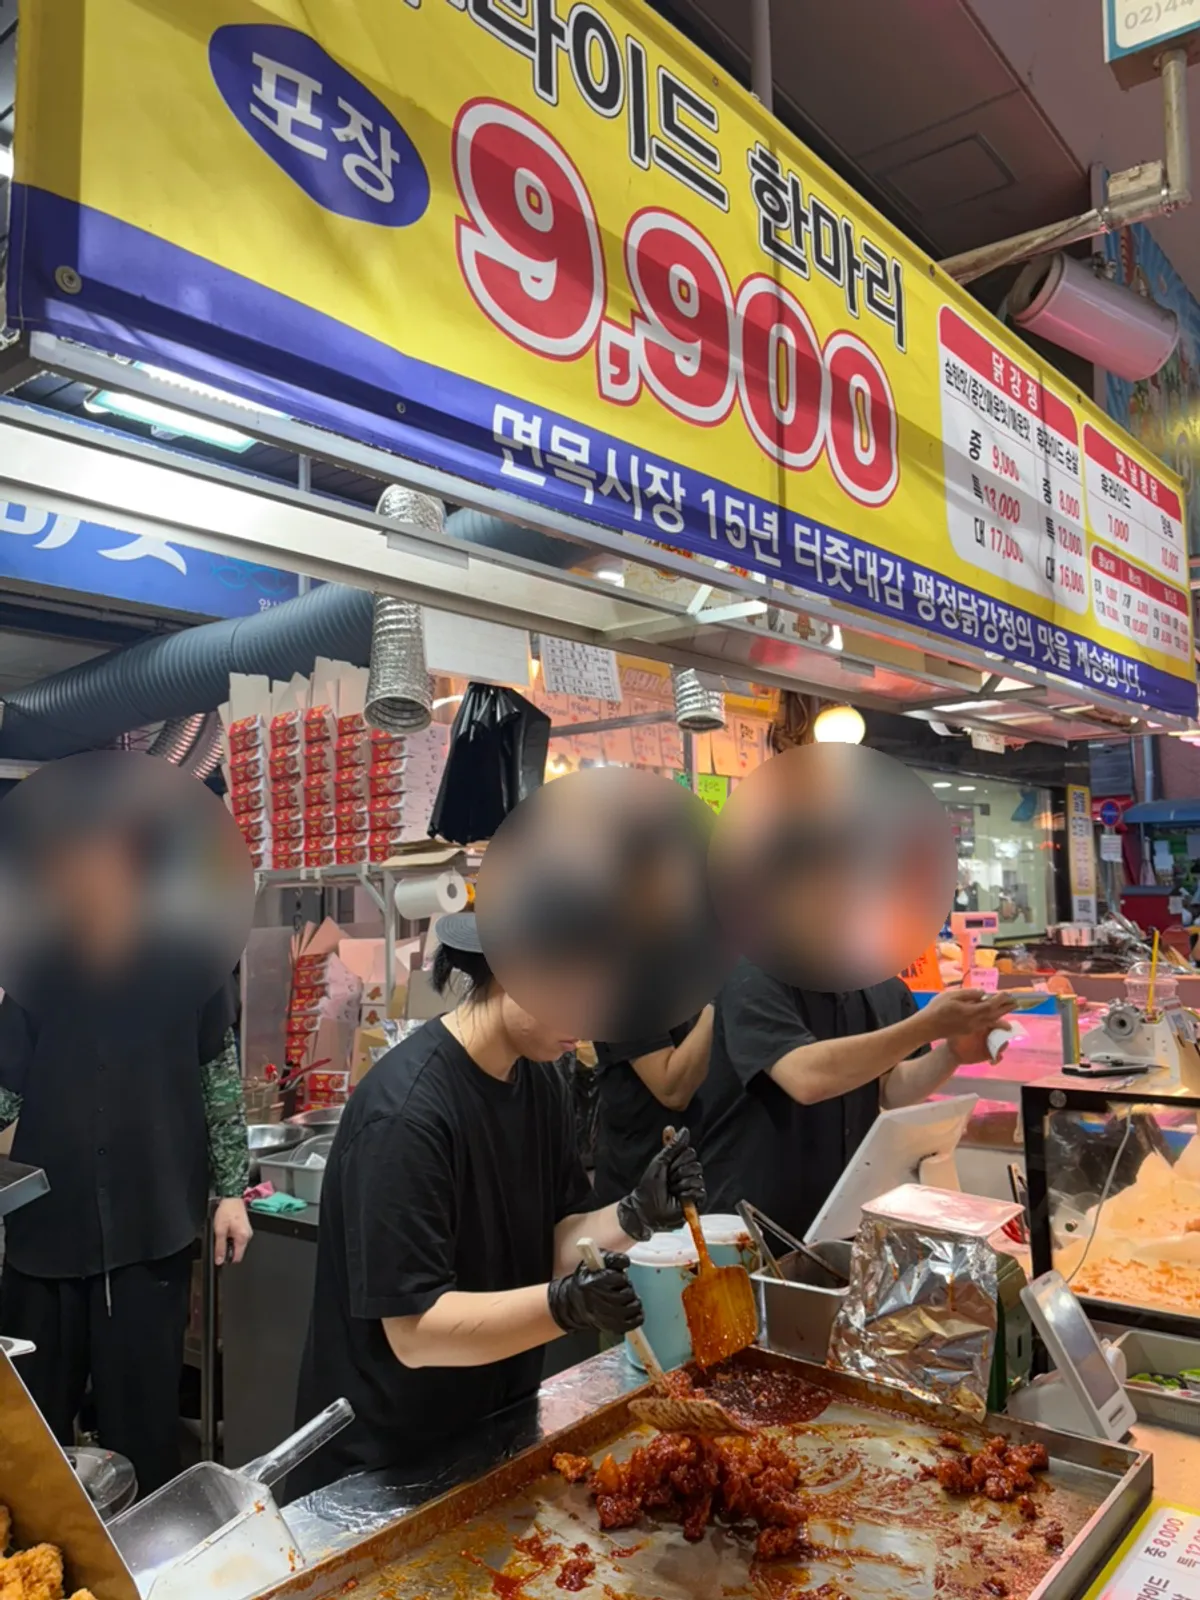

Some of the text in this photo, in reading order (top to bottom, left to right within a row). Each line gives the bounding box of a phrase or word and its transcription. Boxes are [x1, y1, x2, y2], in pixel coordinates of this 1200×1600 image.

[249, 52, 401, 204] 포장
[401, 0, 907, 354] 라이드 한마리
[451, 96, 899, 507] 9,900
[969, 429, 1020, 482] 중 9,000
[984, 485, 1021, 524] 13,000
[1043, 477, 1053, 505] 중
[493, 403, 686, 534] 면목시장
[700, 488, 782, 568] 15년
[793, 522, 905, 612] 터줏대감
[911, 569, 1037, 658] 평정닭강정의
[1037, 622, 1073, 672] 맛을
[974, 516, 1024, 564] 대 17,000
[1058, 525, 1083, 557] 12,000
[1152, 1517, 1184, 1549] 8,000
